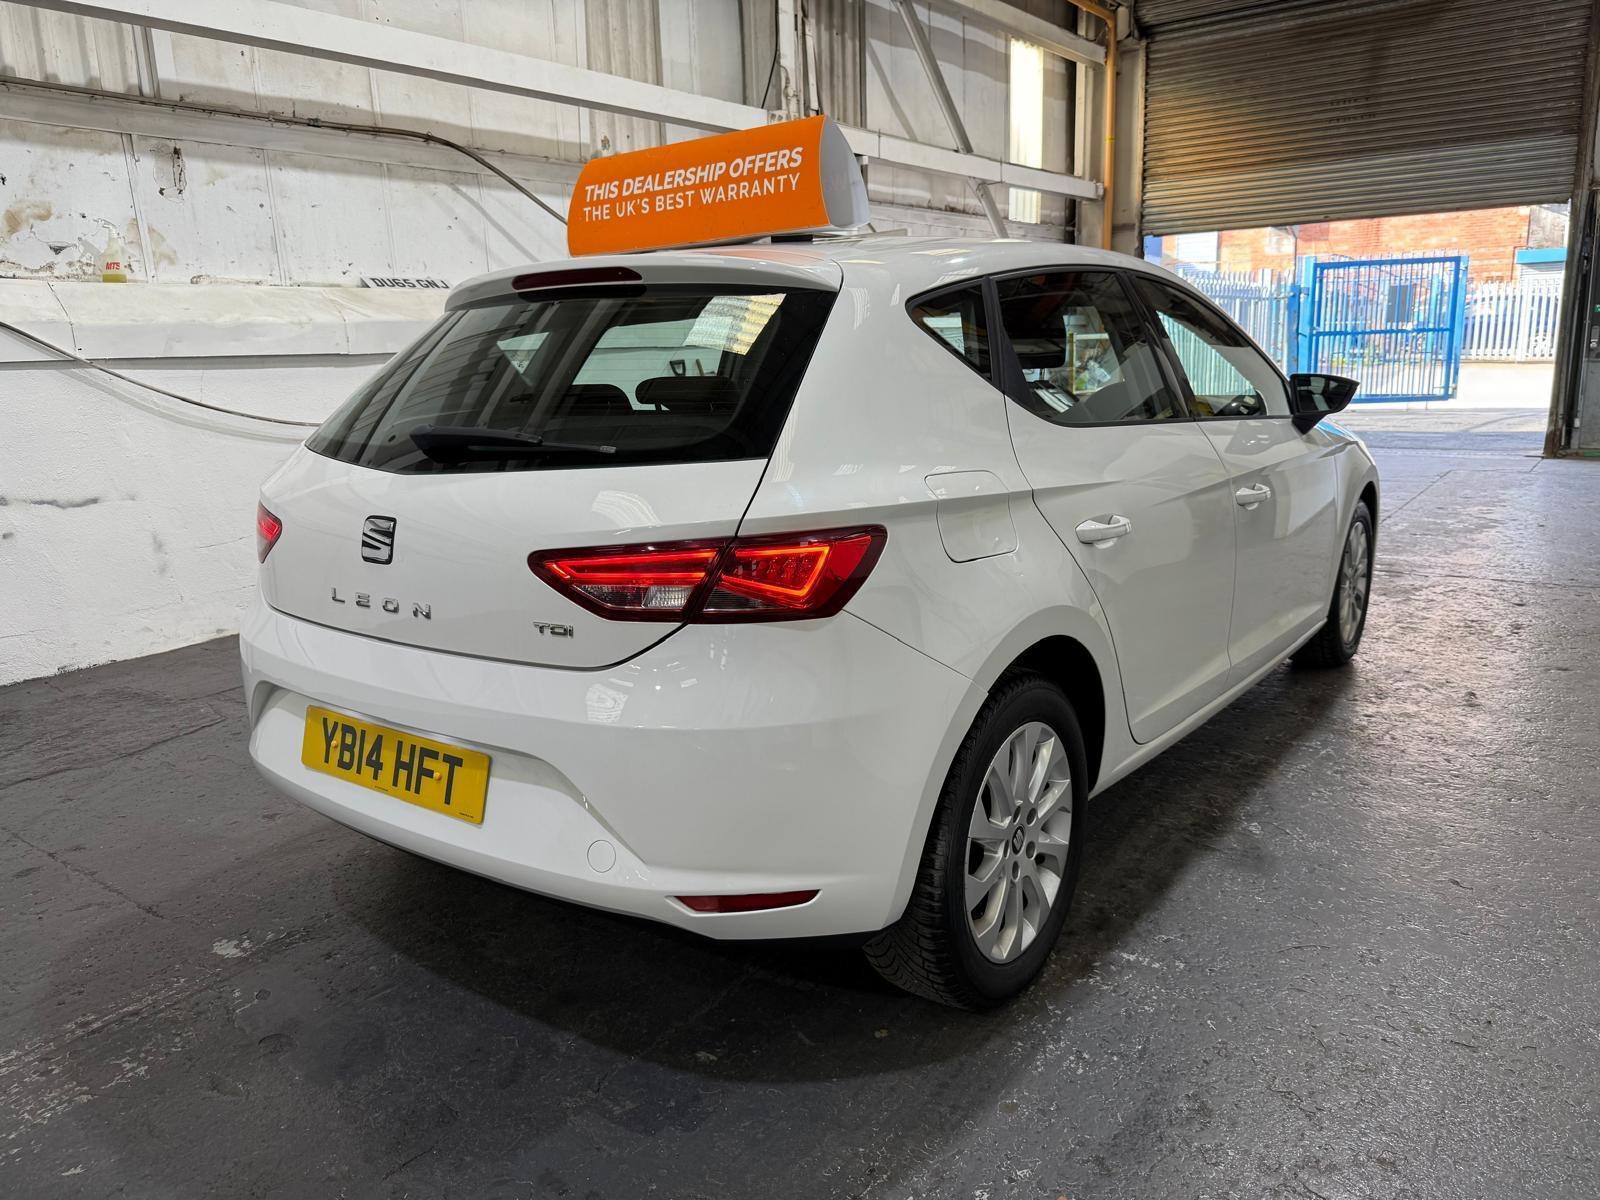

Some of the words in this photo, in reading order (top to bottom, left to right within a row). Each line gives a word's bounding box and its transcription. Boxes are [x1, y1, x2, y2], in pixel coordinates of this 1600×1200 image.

[583, 204, 611, 222] THE
[616, 198, 650, 218] UK'S
[655, 190, 695, 212] BEST
[700, 173, 801, 205] WARRANTY
[585, 181, 619, 203] THIS
[622, 162, 726, 196] DEALERSHIP
[729, 147, 803, 178] OFFERS
[330, 587, 432, 620] LEON
[322, 717, 384, 781] YB14
[392, 740, 464, 806] HFT
